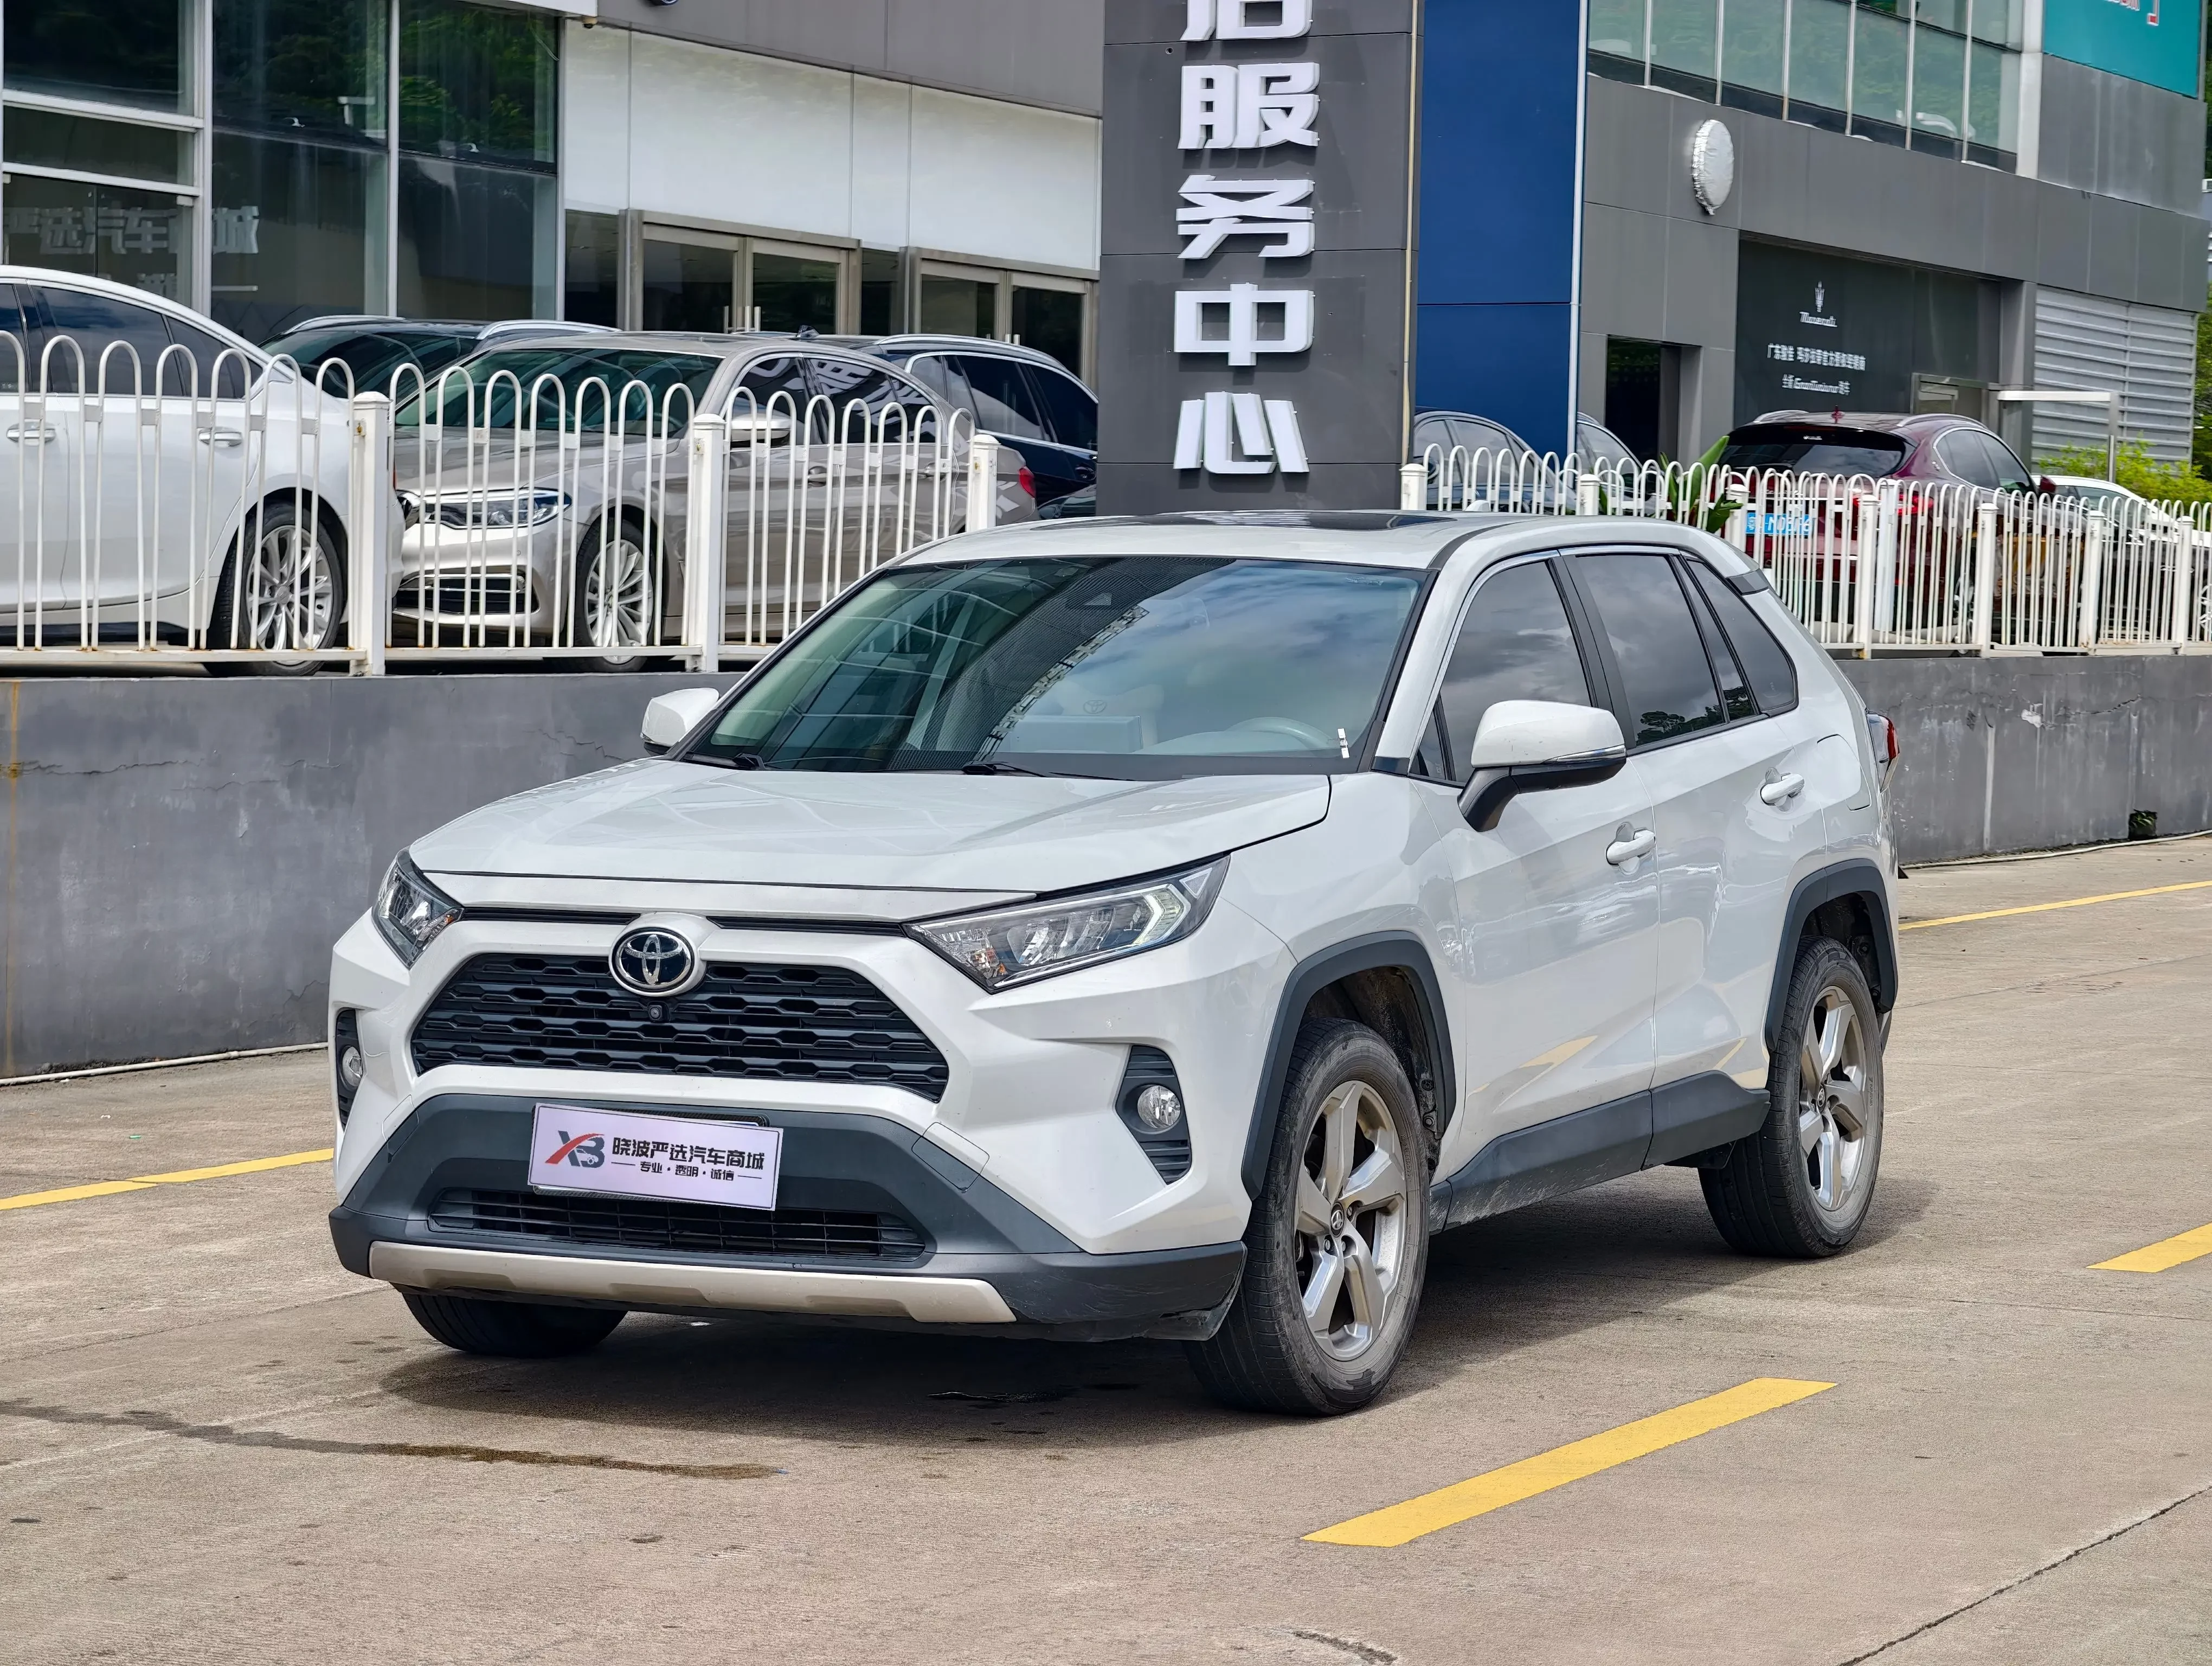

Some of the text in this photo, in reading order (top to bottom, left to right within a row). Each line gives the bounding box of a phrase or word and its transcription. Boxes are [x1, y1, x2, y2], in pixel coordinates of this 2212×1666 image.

[4, 206, 259, 254] 严选汽车城
[612, 1137, 765, 1170] 晓波严选汽车商城
